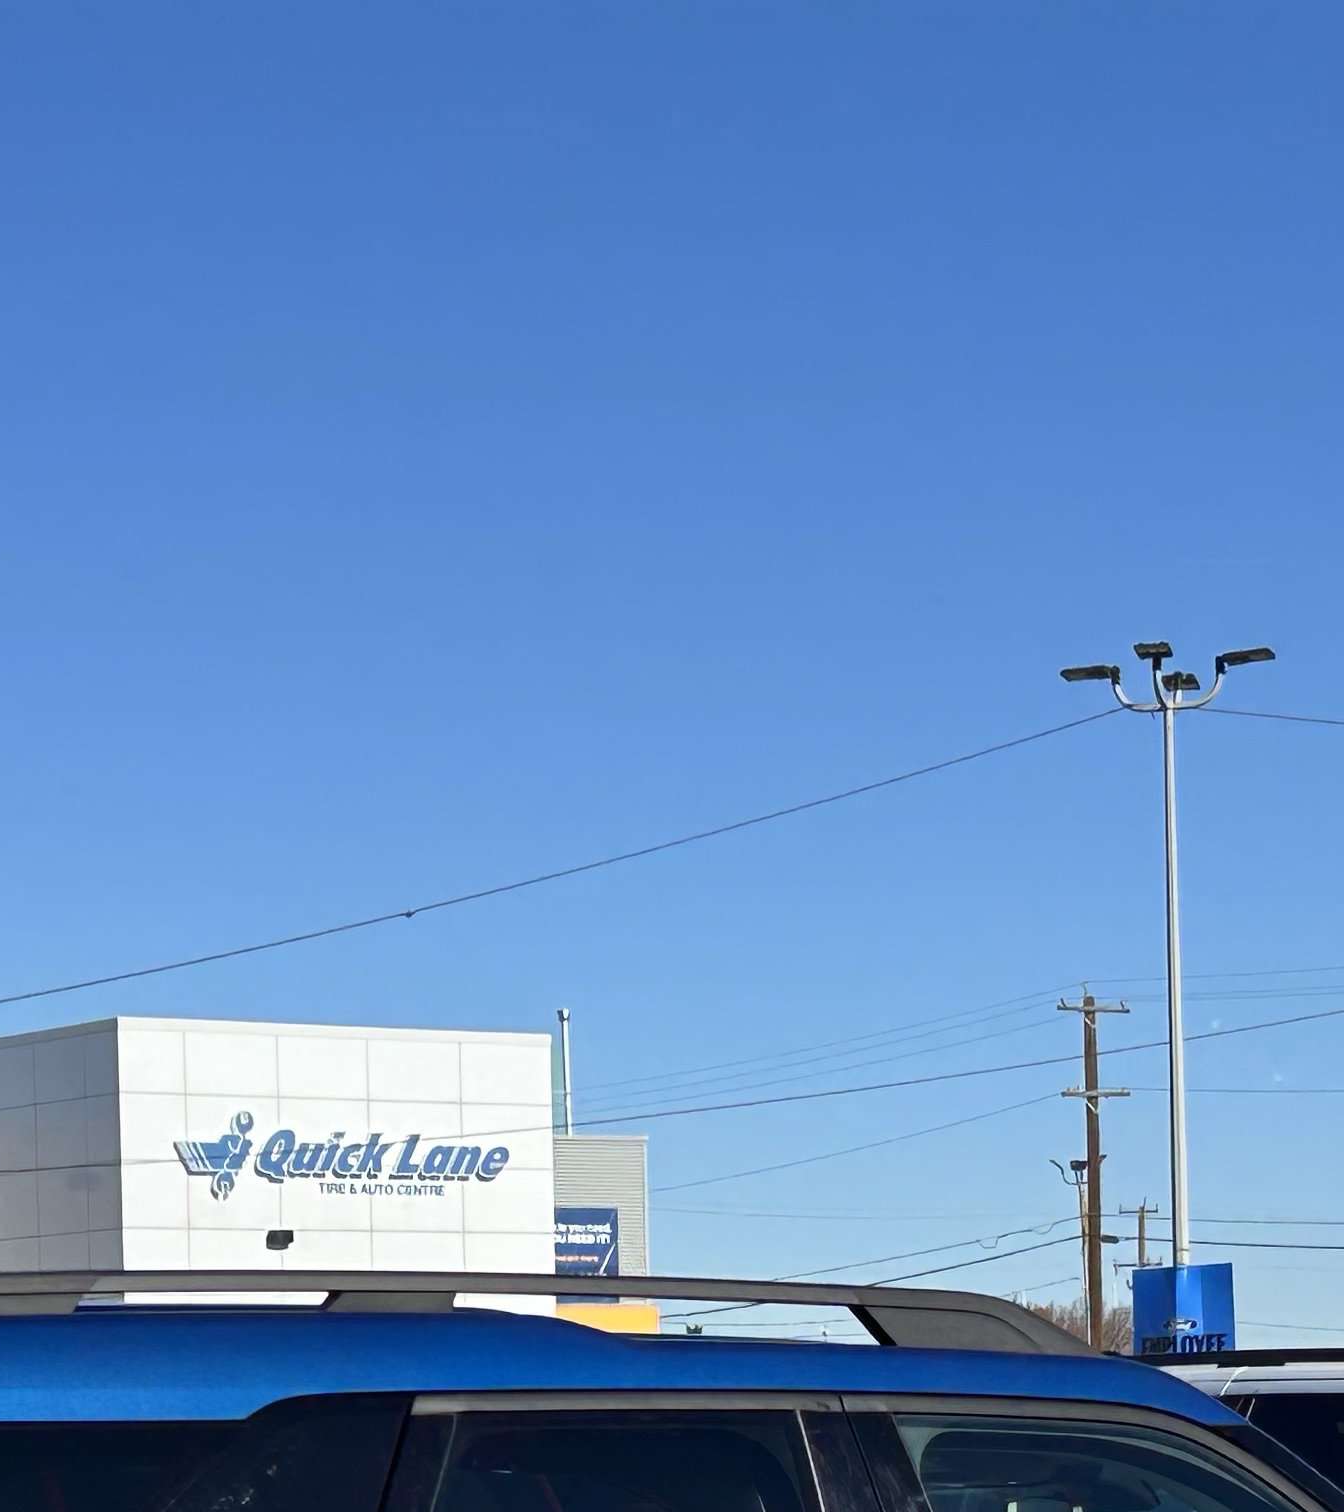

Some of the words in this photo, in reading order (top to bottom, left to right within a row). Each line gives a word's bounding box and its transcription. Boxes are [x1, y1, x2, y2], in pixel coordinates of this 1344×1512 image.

[254, 1129, 392, 1183] Quick
[389, 1134, 510, 1182] Lane
[319, 1182, 346, 1195] TIRE
[361, 1184, 394, 1196] AUTO
